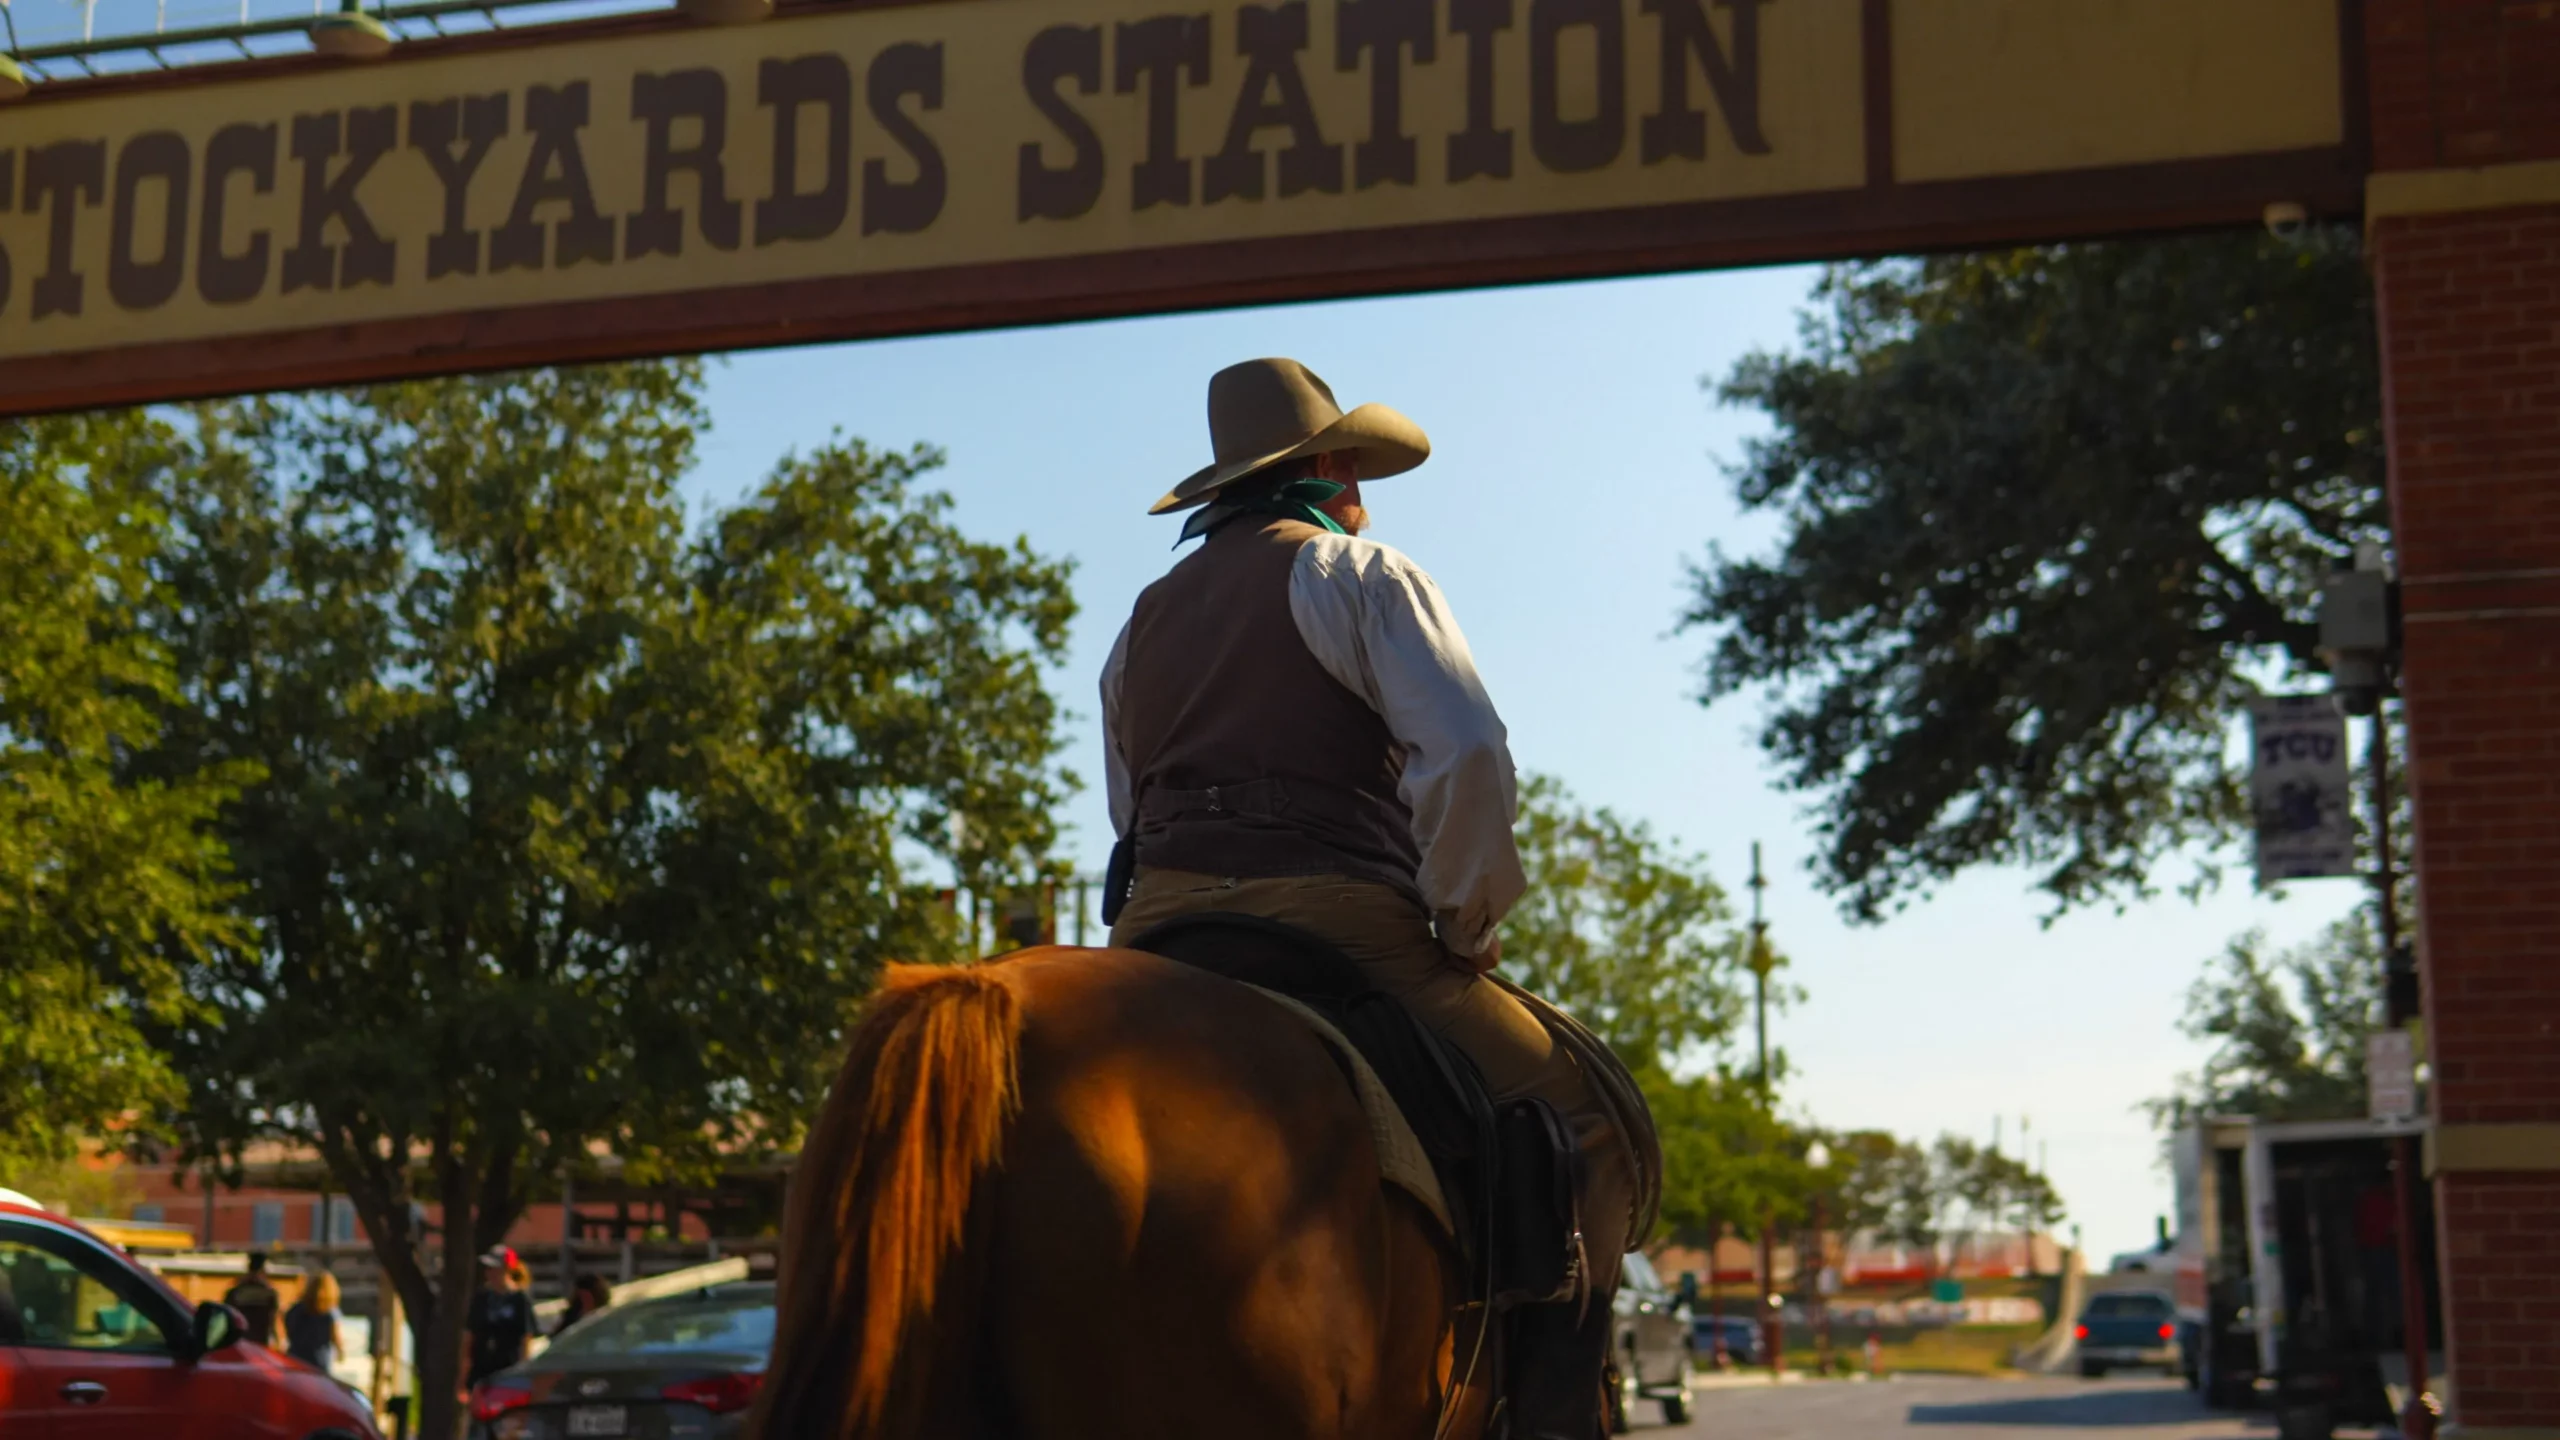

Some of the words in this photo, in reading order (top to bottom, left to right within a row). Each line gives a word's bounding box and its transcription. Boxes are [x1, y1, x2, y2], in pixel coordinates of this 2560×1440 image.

[0, 41, 946, 322] TOCKYARDS
[1017, 0, 1775, 223] STATION
[2261, 731, 2336, 766] TCU
